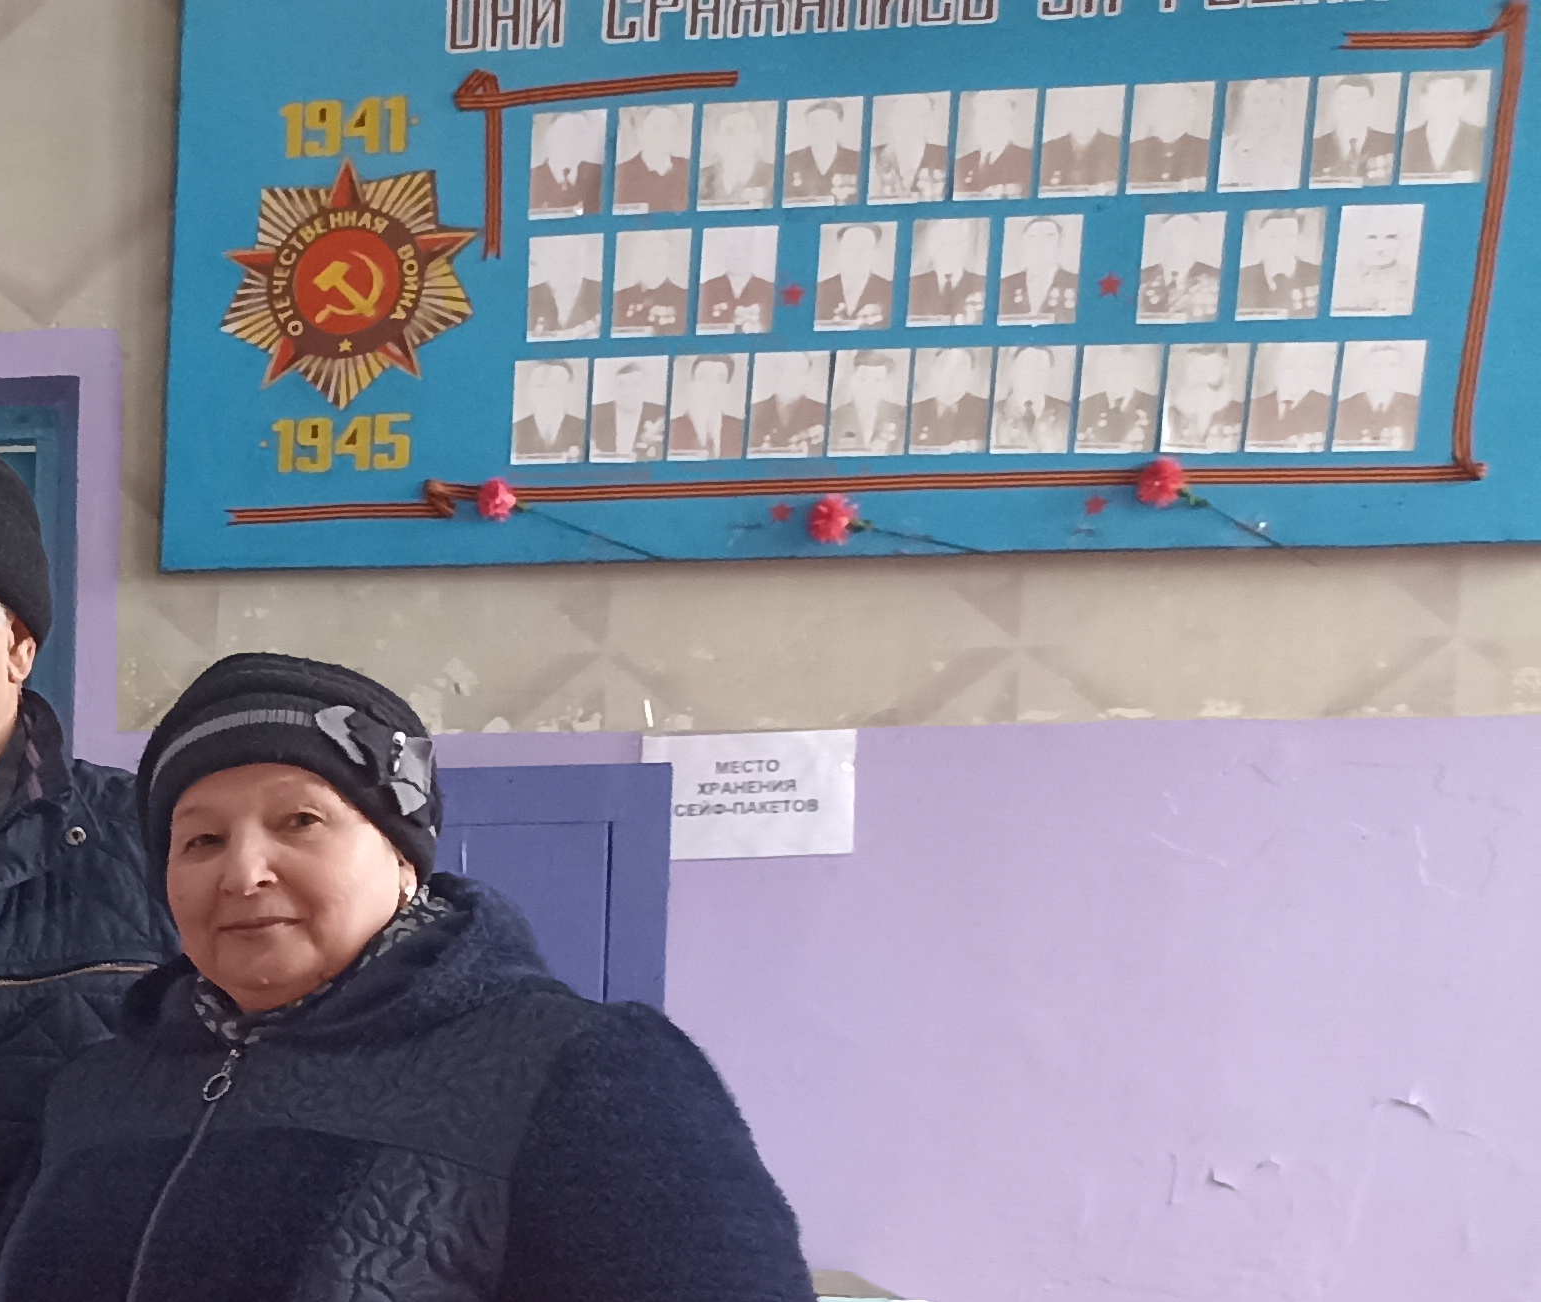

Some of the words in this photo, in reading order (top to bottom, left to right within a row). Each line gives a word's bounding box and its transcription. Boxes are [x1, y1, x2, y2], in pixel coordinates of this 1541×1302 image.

[445, 0, 565, 54] ОНИ
[278, 95, 410, 159] 1941
[272, 211, 390, 337] ОТЕЧЕСТВЕННАЯ
[271, 412, 413, 474] 1945
[696, 778, 798, 796] ХРАНЕНИЯ
[714, 759, 781, 775] МЕСТО
[673, 798, 821, 817] СЕЙФ-ПАКЕТОВ
